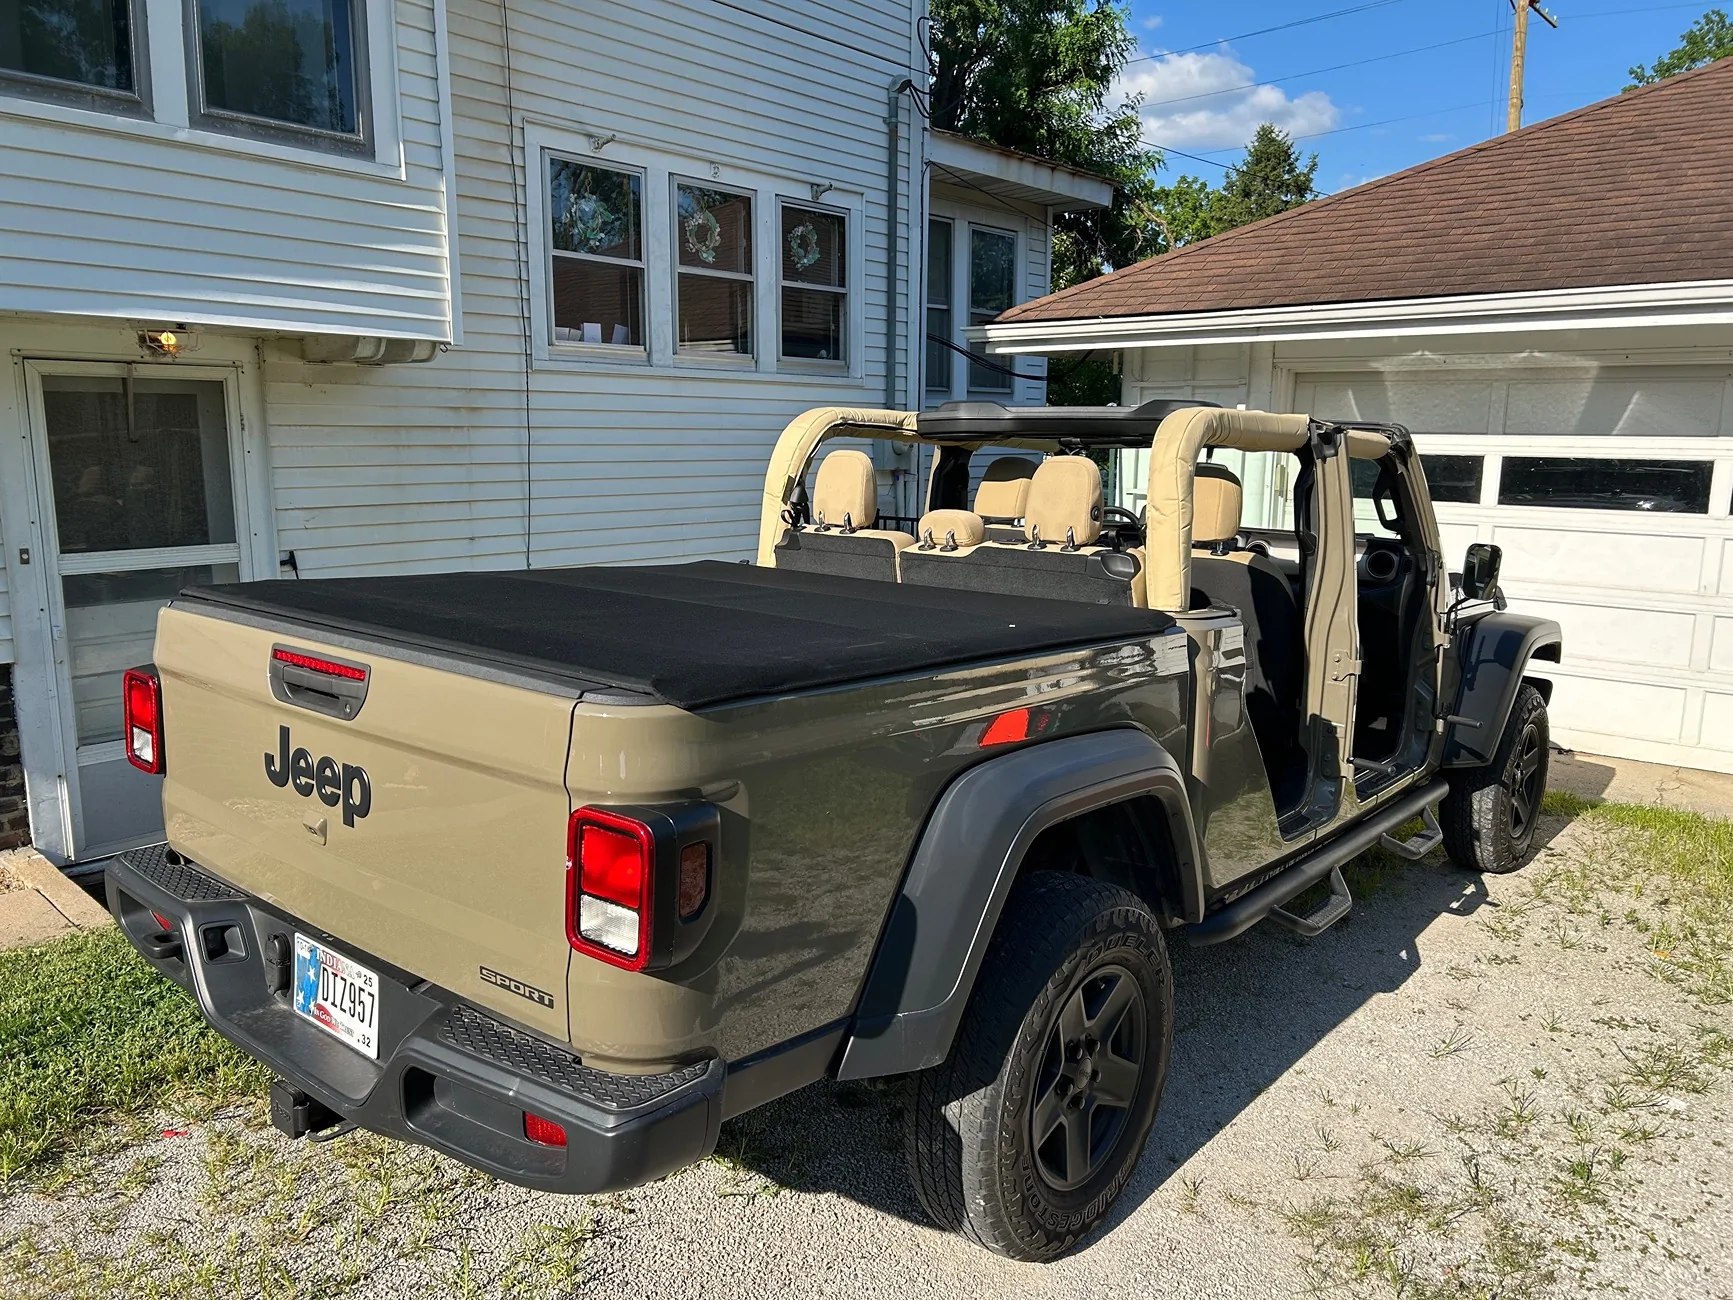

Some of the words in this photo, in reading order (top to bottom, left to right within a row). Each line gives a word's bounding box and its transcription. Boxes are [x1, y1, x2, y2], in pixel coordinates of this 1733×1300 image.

[264, 724, 371, 828] Jeep
[316, 947, 355, 980] INDIANA
[363, 974, 373, 988] 25
[1083, 932, 1167, 988] DUELER
[321, 966, 375, 1029] DIZ957
[480, 966, 554, 1009] SPORT
[361, 1034, 371, 1048] 32
[1020, 1152, 1135, 1233] BRIDGESTONE
